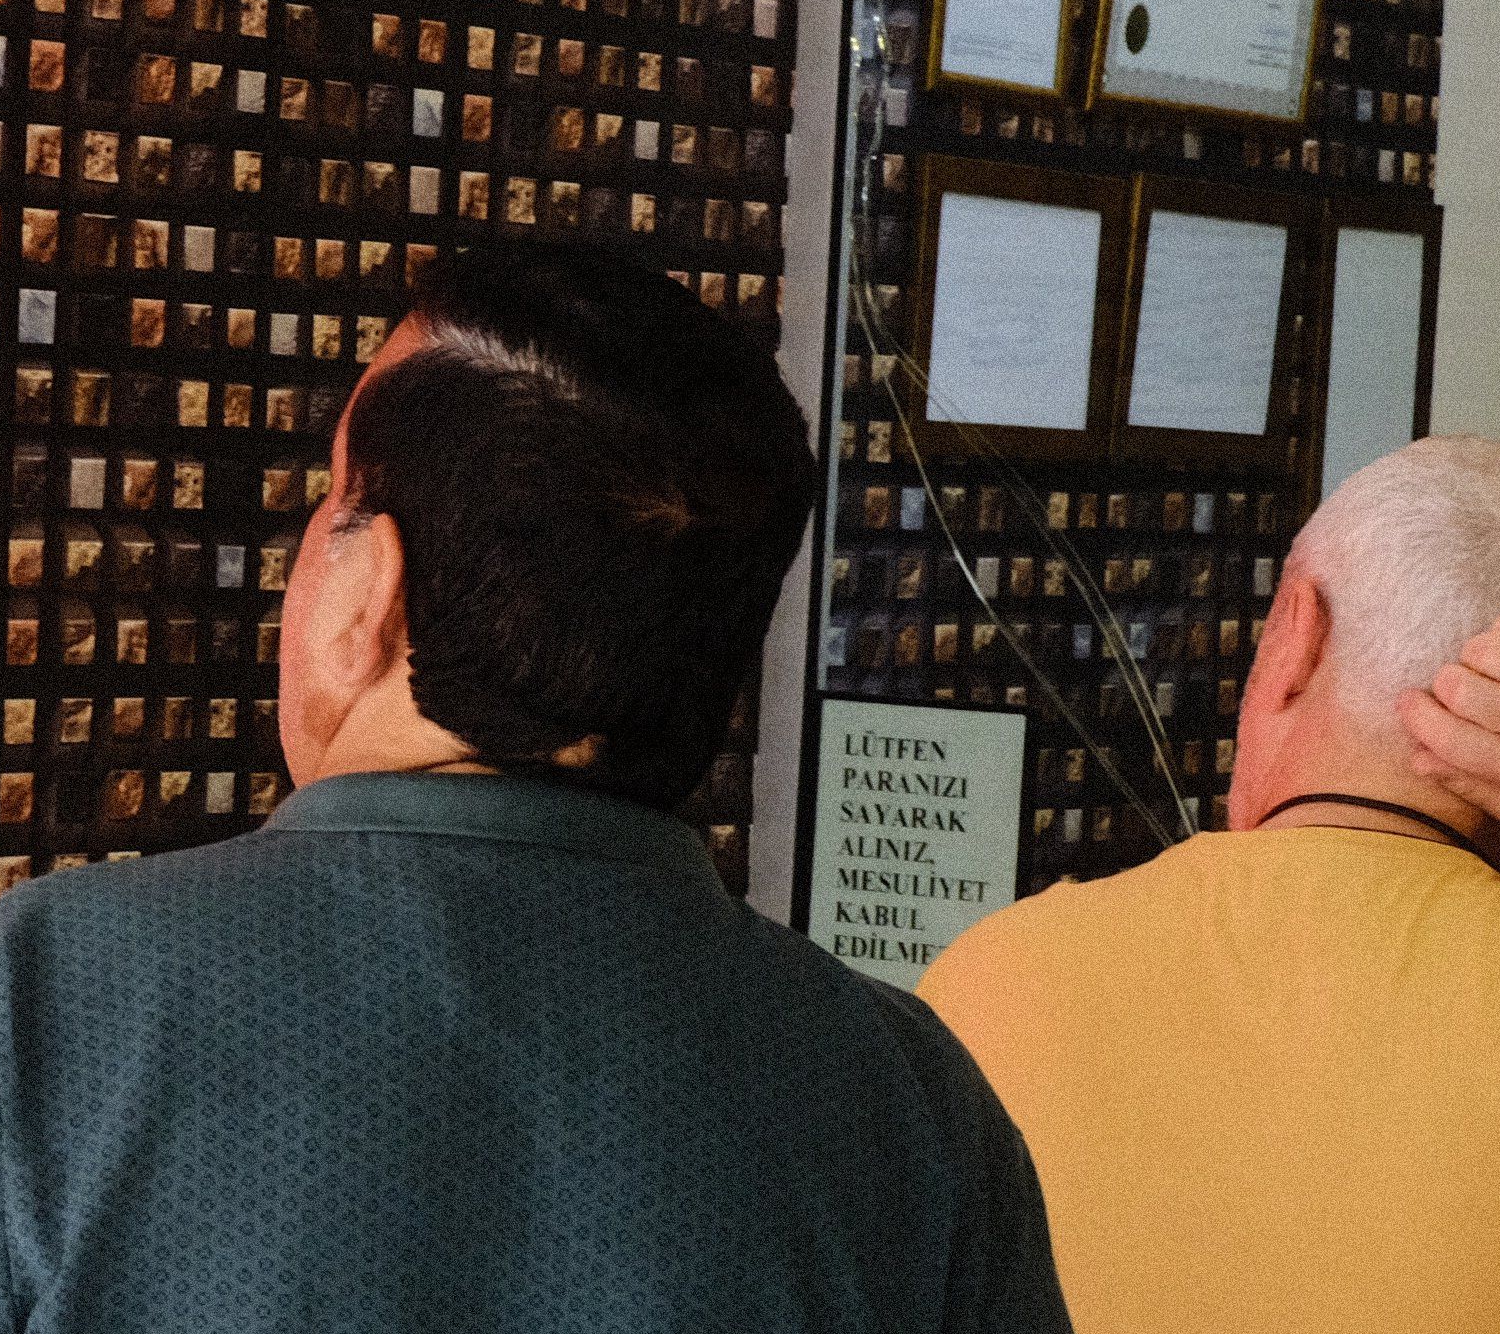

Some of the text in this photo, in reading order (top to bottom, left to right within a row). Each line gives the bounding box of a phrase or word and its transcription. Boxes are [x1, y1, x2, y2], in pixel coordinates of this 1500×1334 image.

[845, 730, 947, 762] LÜTFEN
[843, 767, 967, 799] PARANIZI
[840, 801, 966, 833] SAYARAK
[836, 867, 990, 902] MESULİYET
[835, 900, 925, 931] KABUL
[833, 932, 947, 965] EDİLME
